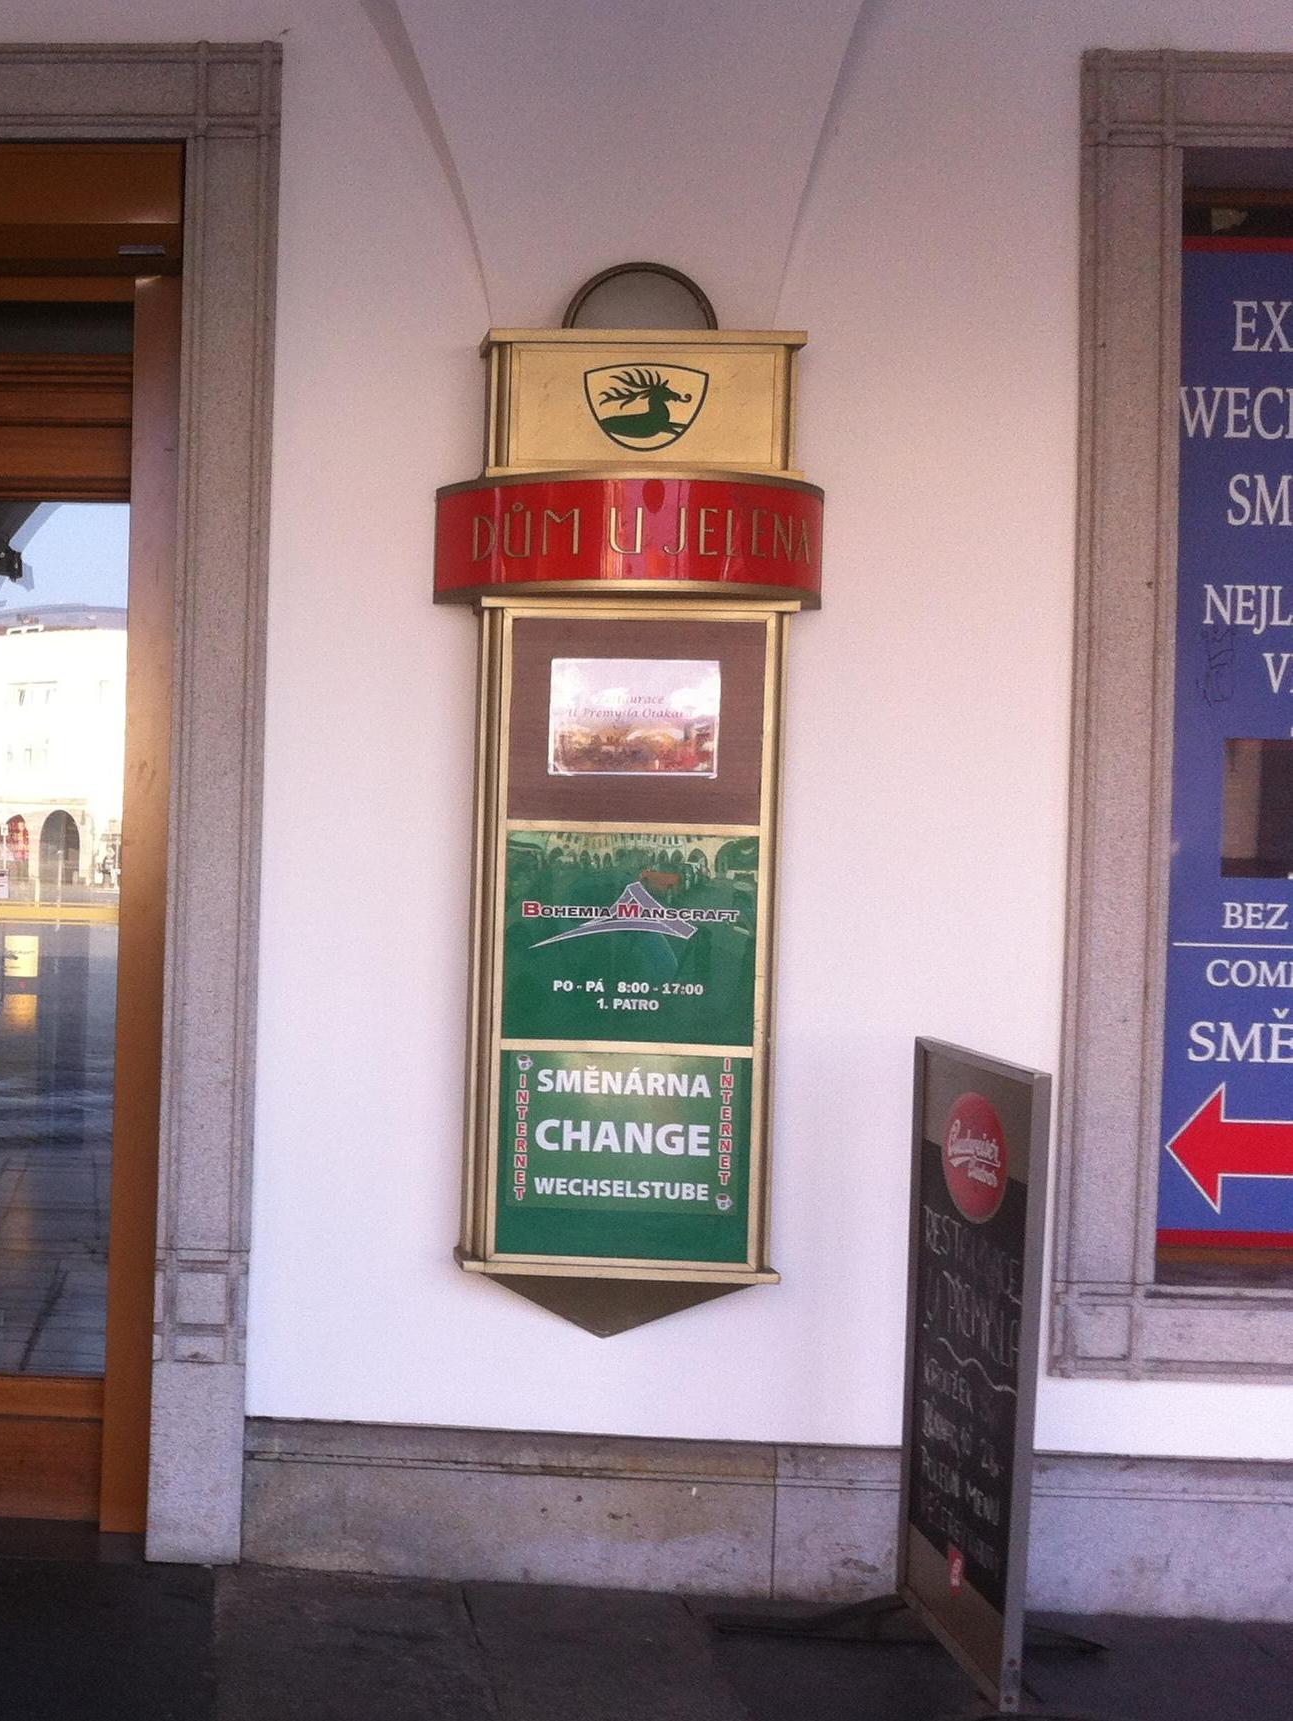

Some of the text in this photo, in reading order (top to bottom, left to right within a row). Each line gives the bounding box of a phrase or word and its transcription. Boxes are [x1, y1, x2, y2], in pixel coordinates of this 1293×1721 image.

[1180, 386, 1293, 440] WEC
[472, 502, 812, 566] DŮM U JELENA
[1262, 652, 1293, 693] V
[1222, 902, 1289, 930] BEZ
[553, 980, 573, 992] PO
[586, 978, 604, 993] PÁ
[617, 981, 650, 994] 8:00
[662, 983, 704, 995] 17:00
[1206, 959, 1293, 988] COM
[613, 999, 659, 1011] PATRO
[537, 1065, 712, 1098] SMĚNÁRNA
[514, 1074, 529, 1201] INTERNET
[535, 1118, 711, 1157] CHANGE
[719, 1057, 734, 1186] INTERNET
[533, 1176, 709, 1201] WECHSELSTUBE
